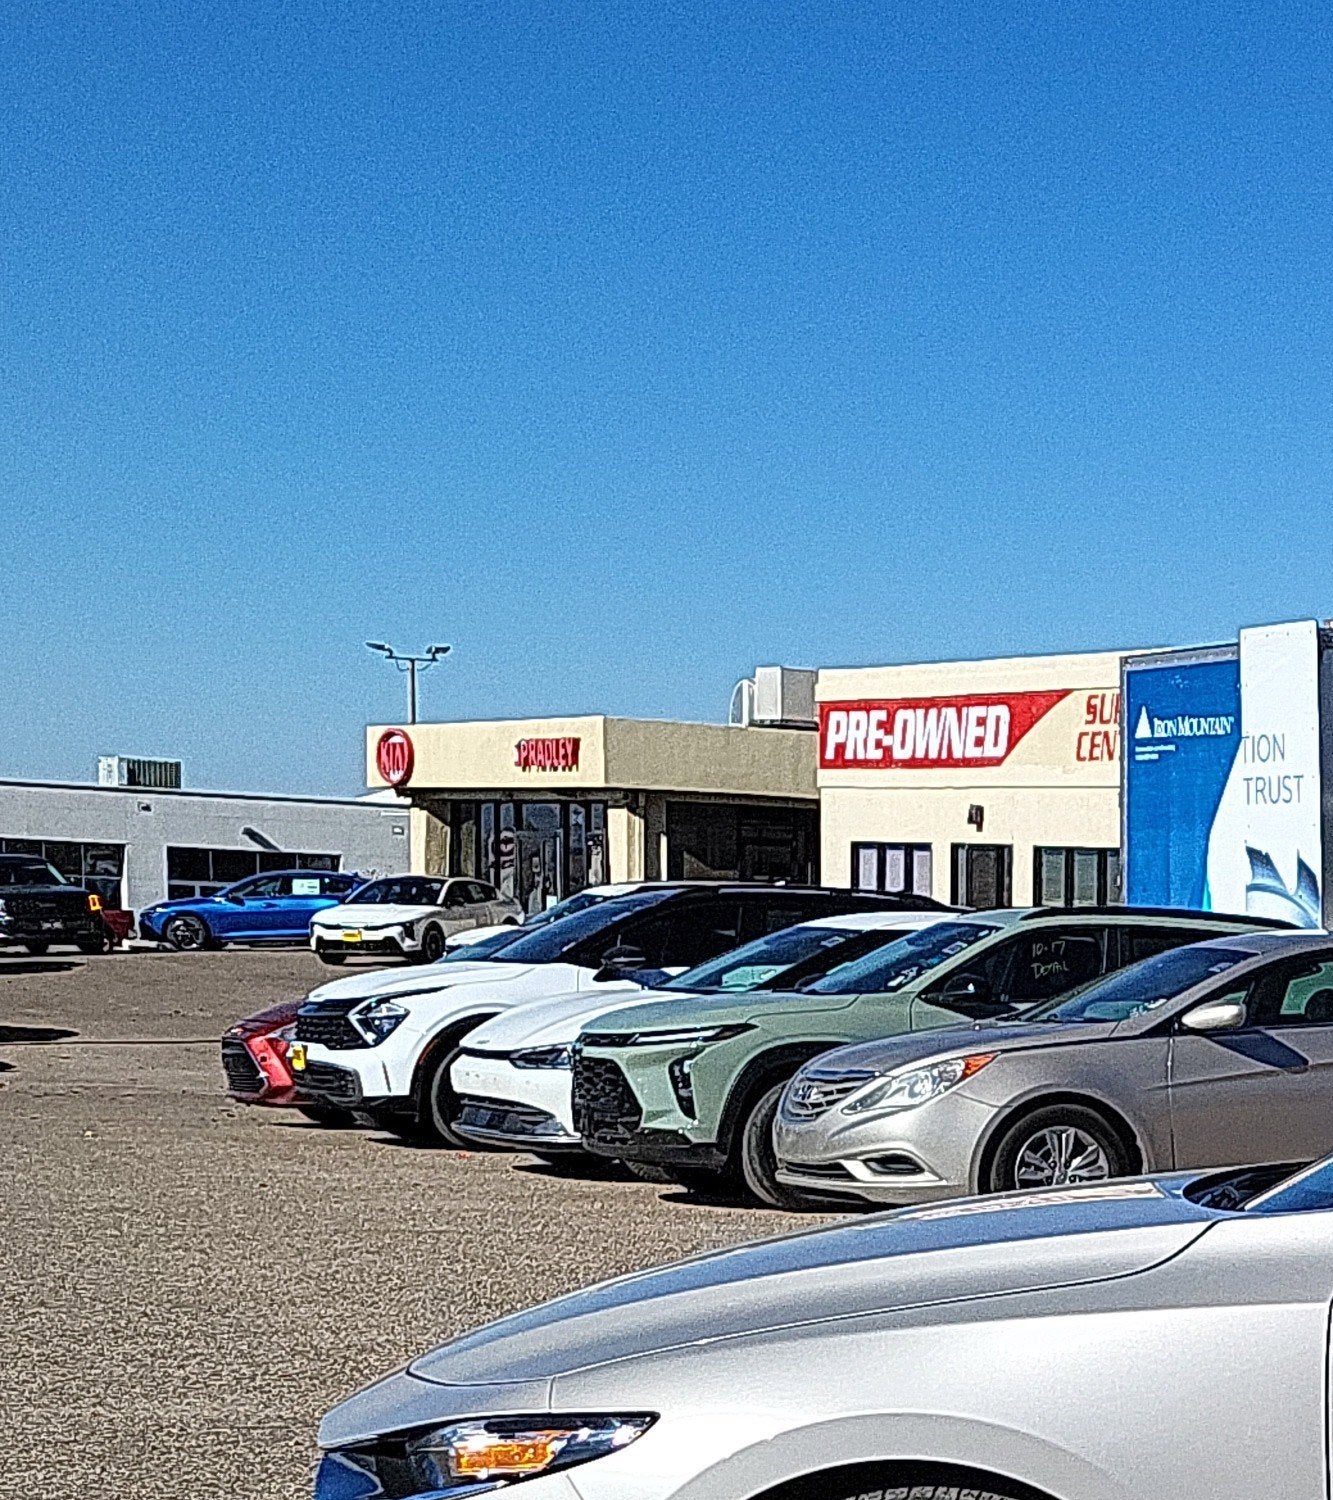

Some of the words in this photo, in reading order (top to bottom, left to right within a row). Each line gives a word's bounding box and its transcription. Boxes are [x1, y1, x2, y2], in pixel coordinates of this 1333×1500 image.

[824, 704, 1010, 760] PRE-OWNED
[380, 741, 409, 775] KIA
[1243, 774, 1305, 806] TRUST
